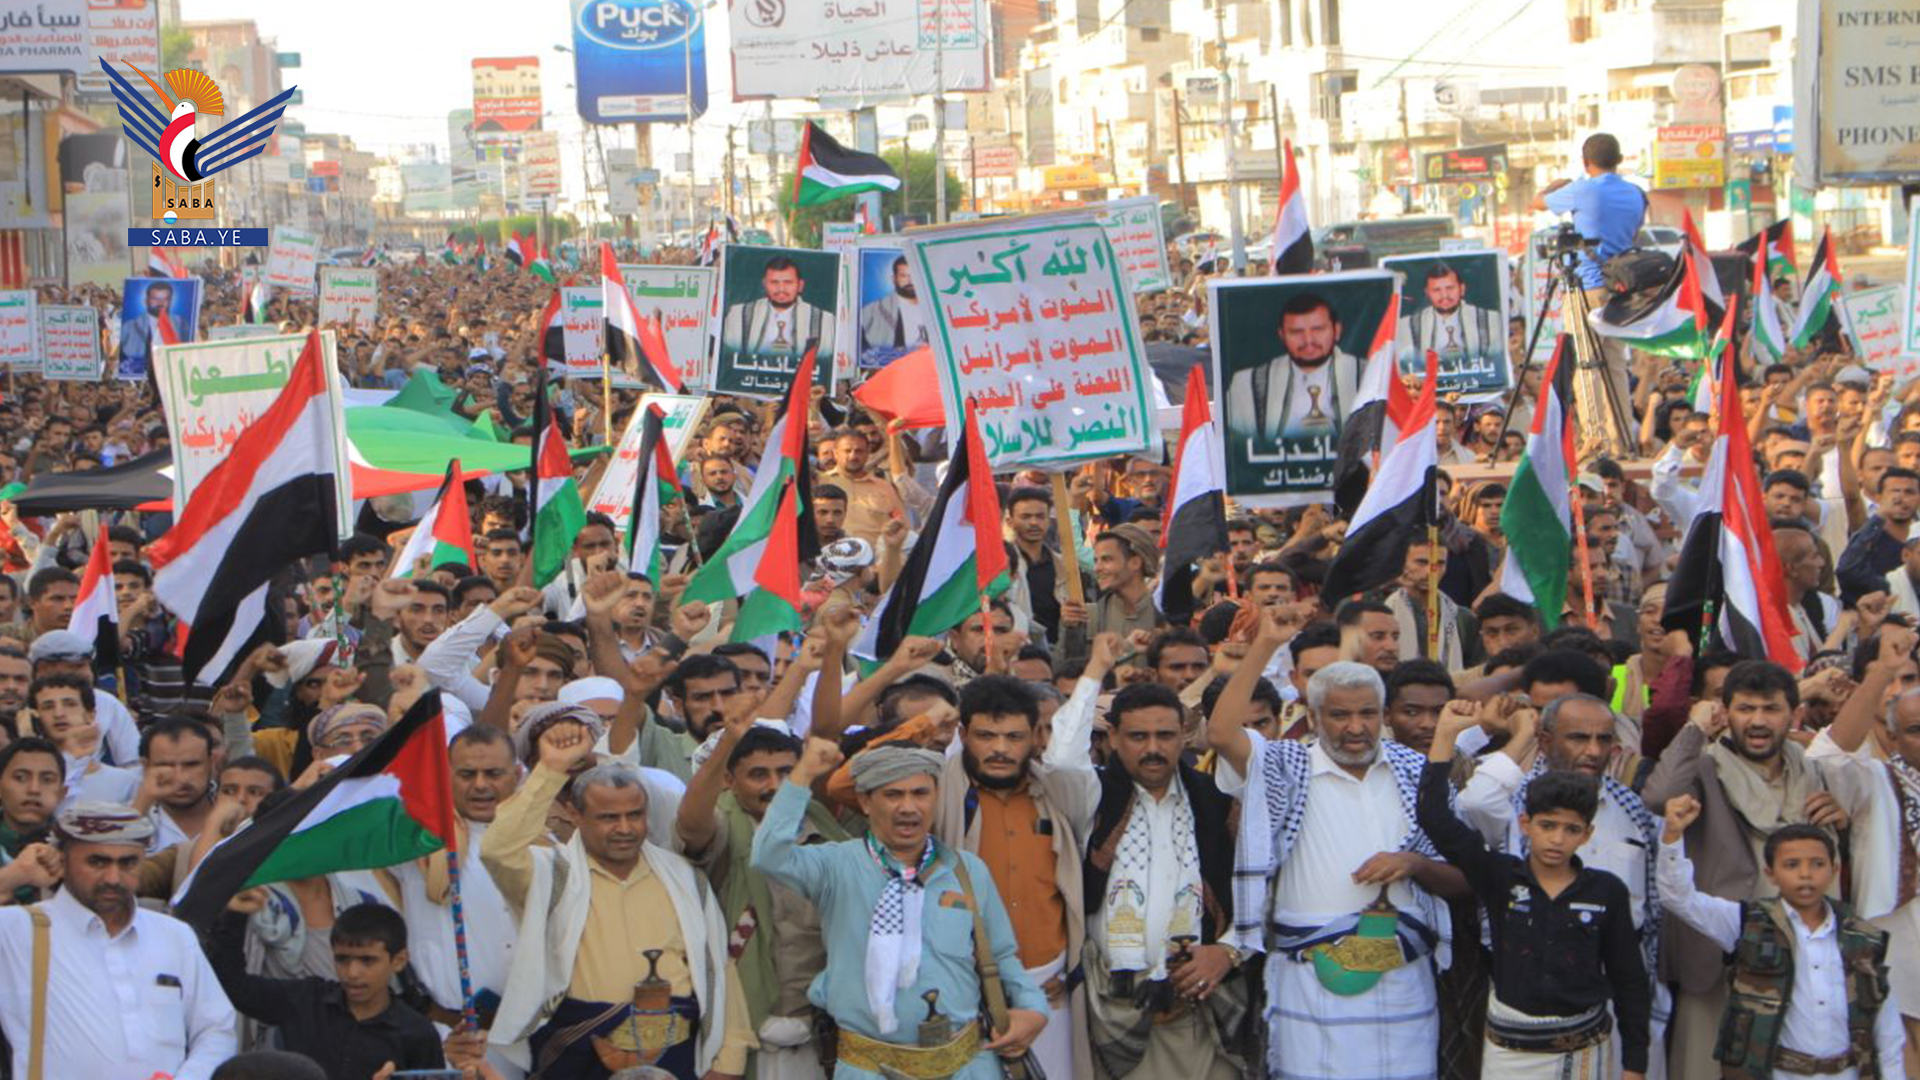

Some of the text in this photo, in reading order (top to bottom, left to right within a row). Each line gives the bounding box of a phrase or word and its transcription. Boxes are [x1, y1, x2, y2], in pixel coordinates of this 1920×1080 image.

[37, 4, 80, 32] سبأ
[597, 2, 684, 28] Puck
[823, 0, 886, 23] الحياة
[19, 46, 82, 56] PHARMA
[811, 40, 862, 63] ذليلا
[865, 40, 912, 62] عاش
[1845, 66, 1901, 87] SMS
[940, 237, 1106, 298] الله أكبر
[947, 289, 1114, 331] الموت لأمريكا
[960, 329, 1123, 374] الموت لإسرائيل
[179, 347, 302, 408] اطعوا
[733, 352, 820, 380] يائدنا
[1408, 356, 1496, 376] ياقائدا
[740, 375, 789, 391] وضناك
[968, 366, 1131, 415] اللعنة على اليهو
[1437, 376, 1480, 393] فوضن
[985, 403, 1137, 459] النصر للاسلا
[1247, 435, 1338, 463] ائدنا
[1263, 465, 1334, 487] وضناك
